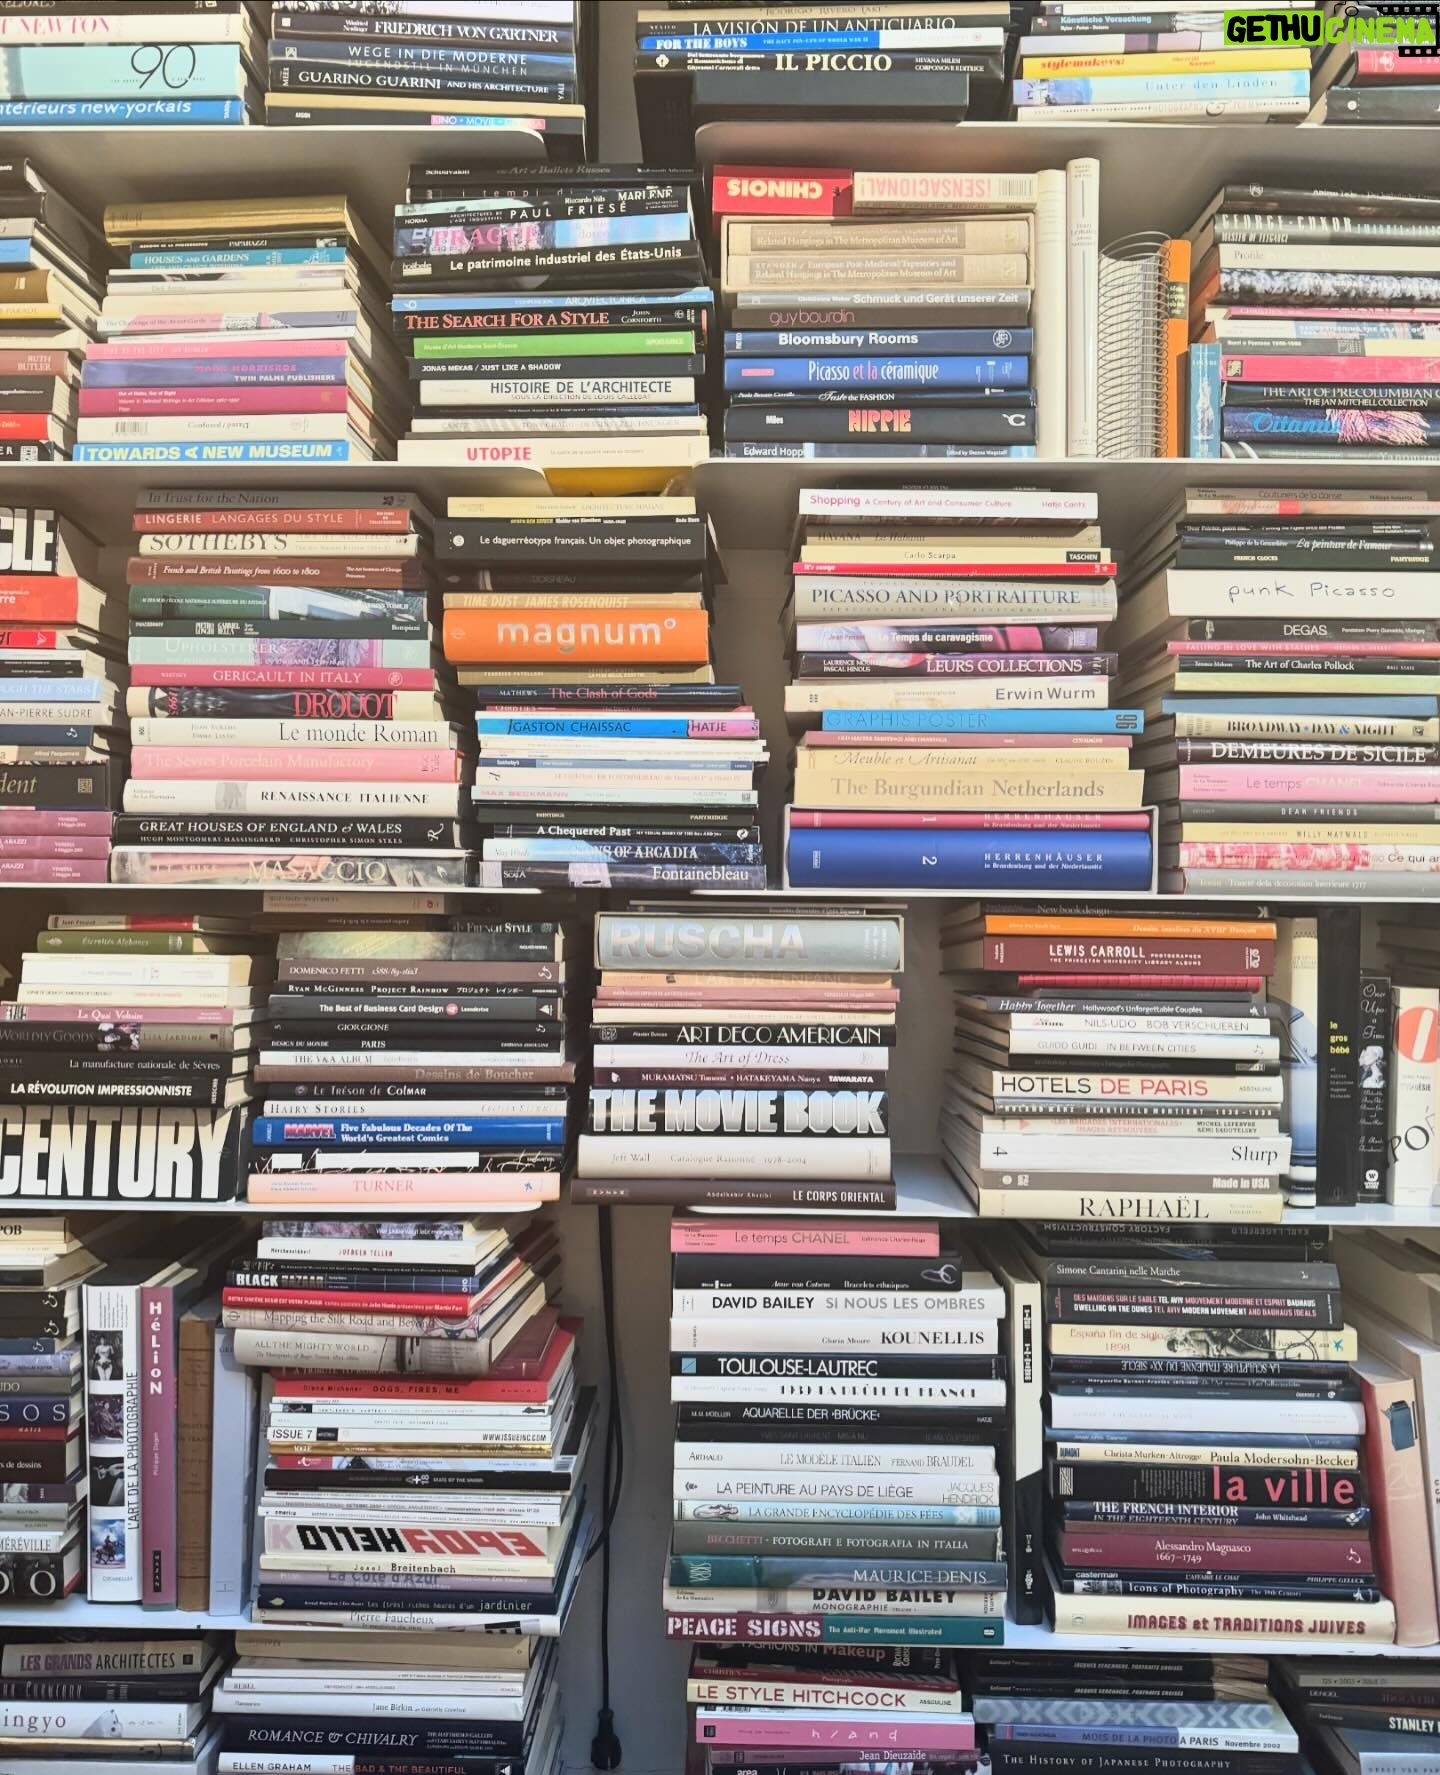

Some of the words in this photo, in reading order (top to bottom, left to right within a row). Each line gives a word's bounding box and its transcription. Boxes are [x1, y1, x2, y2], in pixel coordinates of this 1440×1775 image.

[375, 21, 452, 37] FRIEDRICH
[456, 26, 485, 40] VON
[348, 46, 391, 59] WEGE
[398, 48, 414, 60] IN
[421, 49, 446, 61] DIE
[452, 51, 528, 65] MODERNE
[775, 54, 800, 71] IL
[805, 54, 892, 71] PICCIO
[298, 72, 372, 86] GUARINO
[376, 74, 441, 89] GUARINI
[446, 81, 466, 89] AND
[468, 82, 483, 90] HIS
[484, 83, 549, 94] ARCHITECTURE
[80, 100, 192, 119] new-yorkais
[727, 179, 823, 199] CHINOIS
[510, 208, 552, 220] PAUL
[568, 202, 627, 216] FRIESÉ
[450, 261, 464, 271] Le
[467, 256, 531, 273] patrimoine
[535, 252, 591, 266] industriel
[595, 251, 616, 263] des
[620, 246, 682, 261] États-Unis
[853, 293, 901, 304] Schmuck
[903, 293, 922, 304] und
[926, 293, 954, 304] Gerät
[957, 294, 995, 303] unserer
[998, 292, 1018, 303] Zeit
[405, 314, 439, 329] THE
[442, 312, 506, 328] SEARCH
[510, 312, 543, 326] FOR
[546, 314, 557, 325] A
[561, 311, 609, 325] STYLE
[778, 332, 864, 347] Bloomsbury
[868, 332, 919, 345] Rooms
[259, 374, 285, 382] PALMS
[287, 373, 336, 381] PUBLISHERS
[808, 360, 850, 381] Picasso
[853, 361, 865, 380] et
[867, 360, 878, 380] la
[881, 360, 939, 384] céramique
[490, 381, 550, 394] HISTOIRE
[556, 381, 574, 394] DE
[580, 380, 672, 394] L'ARCHITECTE
[848, 409, 912, 432] HIPPIE
[87, 446, 180, 461] TOWARDS
[203, 446, 245, 459] NEW
[248, 445, 332, 458] MUSEUM
[467, 447, 532, 461] UTOPIE
[810, 494, 861, 507] Shopping
[145, 513, 202, 525] LINGERIE
[212, 512, 278, 524] LANGAGES
[284, 512, 301, 523] DU
[307, 512, 344, 524] STYLE
[480, 536, 491, 546] Le
[492, 535, 552, 546] daguerréotype
[554, 535, 588, 546] français.
[589, 536, 602, 545] Un
[604, 536, 626, 547] objet
[627, 536, 692, 547] photographique
[1069, 553, 1098, 561] TASCHEN
[812, 588, 890, 604] PICASSO
[897, 588, 938, 604] AND
[945, 589, 1081, 604] PORTRAITURE
[1228, 580, 1295, 603] punk
[1310, 582, 1395, 598] Picasso
[1283, 624, 1328, 636] DEGAS
[926, 659, 974, 673] LEURS
[977, 659, 1083, 674] COLLECTIONS
[995, 687, 1043, 700] Erwin
[1047, 687, 1096, 700] Wurm
[293, 691, 398, 719] DROUOT
[279, 722, 300, 741] Le
[306, 722, 367, 742] monde
[374, 725, 438, 743] Roman
[513, 721, 565, 732] GASTON
[570, 721, 632, 733] CHAISSAC
[690, 721, 727, 733] HATJE
[1211, 741, 1326, 760] DEMEURES
[1331, 744, 1359, 762] DE
[1362, 745, 1427, 763] SICILE
[831, 777, 869, 796] The
[874, 776, 984, 799] Burgundian
[992, 777, 1105, 797] Netherlands
[139, 822, 184, 833] GREAT
[188, 822, 243, 833] HOUSES
[247, 822, 267, 833] OF
[270, 822, 338, 834] ENGLAND
[356, 823, 403, 834] WALES
[653, 866, 750, 881] Fontainebleau
[611, 919, 809, 961] RUSCHA
[1049, 944, 1085, 957] LEWIS
[1090, 945, 1145, 958] CARROLL
[676, 1025, 712, 1043] ART
[718, 1026, 772, 1044] DECO
[776, 1026, 881, 1044] AMERICAIN
[10, 1083, 25, 1094] LA
[28, 1081, 95, 1095] RÉVOLUTION
[98, 1084, 193, 1096] IMPRESSIONNISTE
[1001, 1076, 1092, 1094] HOTELS
[1100, 1079, 1131, 1095] DE
[1140, 1078, 1209, 1096] PARIS
[589, 1088, 657, 1132] THE
[664, 1089, 778, 1133] MOVIE
[783, 1090, 887, 1134] BOOK
[1230, 1145, 1278, 1165] Slurp
[1080, 1195, 1210, 1218] RAPHAËL
[712, 1296, 758, 1309] DAVID
[762, 1296, 815, 1309] BAILEY
[825, 1297, 839, 1309] SI
[844, 1297, 888, 1309] NOUS
[893, 1298, 919, 1309] LES
[924, 1298, 985, 1310] OMBRES
[880, 1331, 985, 1345] KOUNELLIS
[718, 1357, 878, 1377] TOULOUSE-LAUTREC
[126, 1371, 139, 1460] PHOTOGRAPHIE
[127, 1462, 139, 1479] LA
[127, 1482, 139, 1499] DE
[716, 1482, 734, 1494] LA
[736, 1482, 796, 1495] PEINTURE
[799, 1483, 819, 1496] AU
[822, 1484, 855, 1497] PAYS
[857, 1486, 875, 1497] DE
[877, 1484, 914, 1498] LIÈGE
[1212, 1465, 1249, 1502] la
[1263, 1466, 1355, 1504] ville
[1092, 1500, 1119, 1514] THE
[1123, 1501, 1174, 1516] FRENCH
[1178, 1502, 1239, 1517] INTERIOR
[1155, 1539, 1204, 1552] Alessandro
[1206, 1541, 1252, 1554] Magnasco
[853, 1570, 930, 1584] MAURICE
[933, 1571, 988, 1583] DENIS
[667, 1616, 738, 1637] PEACE
[747, 1618, 822, 1638] SIGNS
[1127, 1613, 1187, 1630] IMAGES
[1193, 1618, 1210, 1631] et
[1214, 1616, 1305, 1635] TRADITIONS
[1308, 1620, 1366, 1635] JUIVES
[697, 1684, 719, 1699] LE
[726, 1685, 785, 1701] STYLE
[792, 1688, 906, 1707] HITCHCOCK
[248, 1728, 325, 1744] ROMANCE
[345, 1731, 420, 1747] CHIVALRY
[1154, 1757, 1231, 1769] PHOTOGRAPHY
